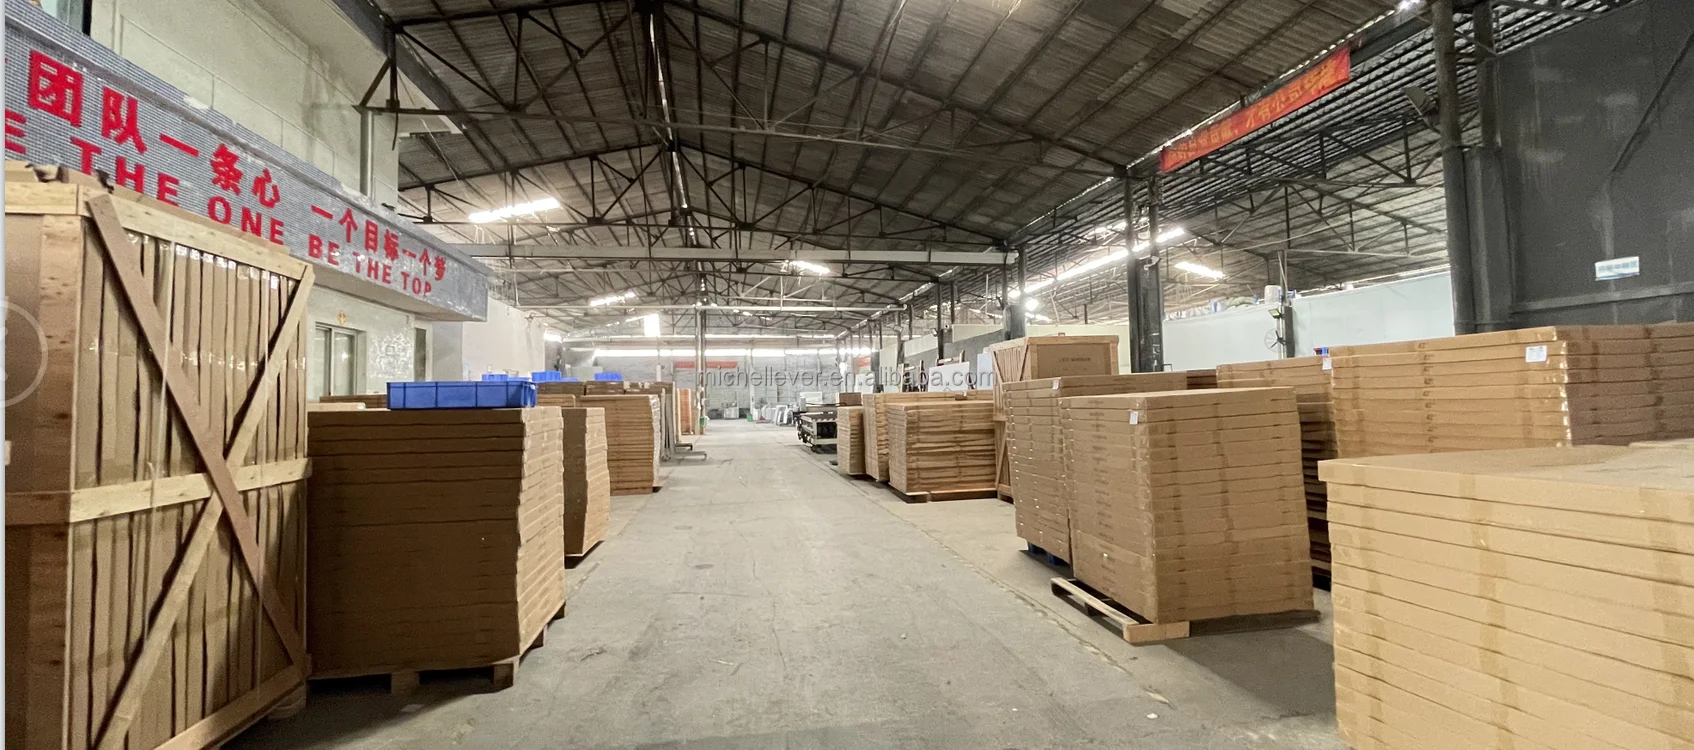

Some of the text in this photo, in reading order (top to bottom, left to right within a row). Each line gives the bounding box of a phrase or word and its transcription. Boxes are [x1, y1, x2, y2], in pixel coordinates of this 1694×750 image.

[5, 49, 446, 281] 团队一条心 一个目标一个梦
[70, 136, 179, 207] THE
[207, 196, 284, 245] ONE
[308, 234, 340, 266] BE
[353, 251, 392, 284] THE
[401, 271, 432, 297] TOP
